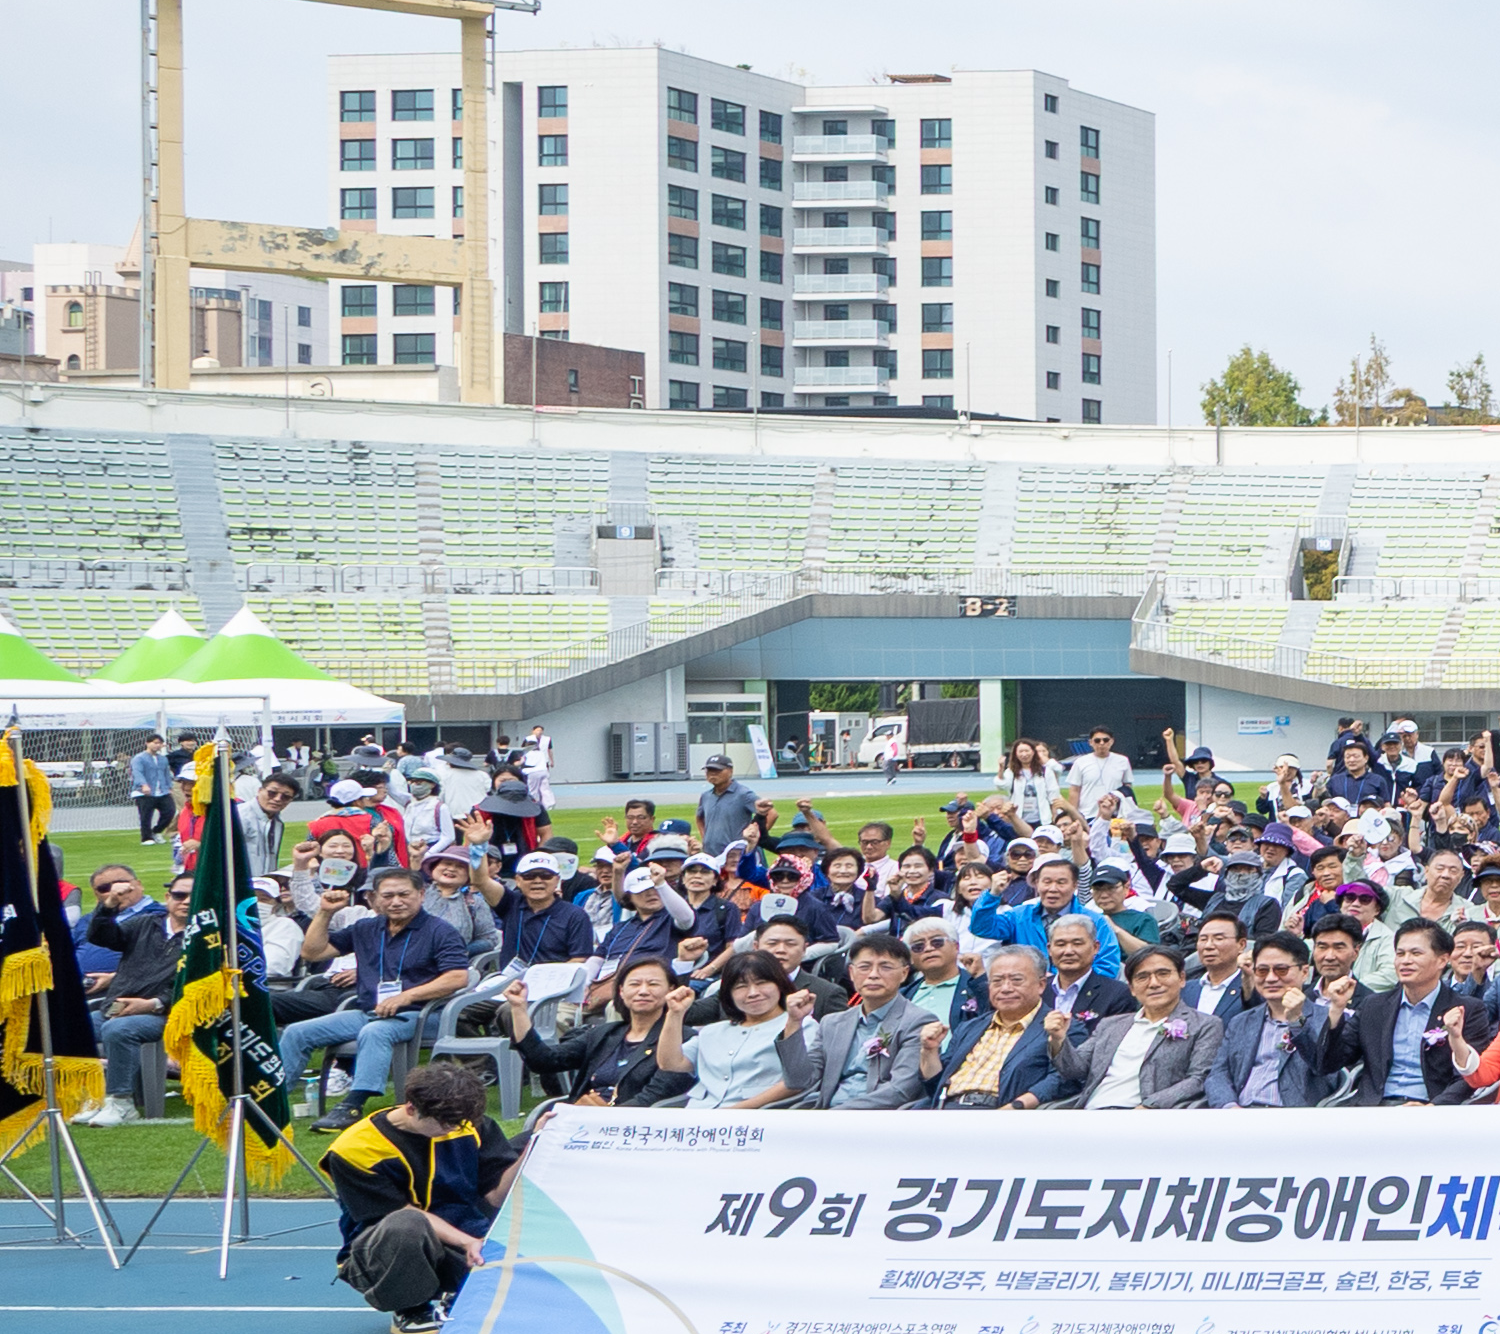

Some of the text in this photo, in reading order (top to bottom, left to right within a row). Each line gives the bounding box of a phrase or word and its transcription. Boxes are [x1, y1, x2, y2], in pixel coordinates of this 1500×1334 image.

[620, 526, 631, 537] 9
[964, 597, 1009, 617] B-2
[252, 714, 324, 724] 동천시지회
[590, 1140, 614, 1151] 법인
[598, 1124, 766, 1148] 사단 한국지체장애인협회
[704, 1176, 867, 1239] 제9회
[878, 1269, 1483, 1293] 휠체어경주, 빅볼굴리기, 볼튀기기, 미니파크골프, 슐런, 한궁, 투호
